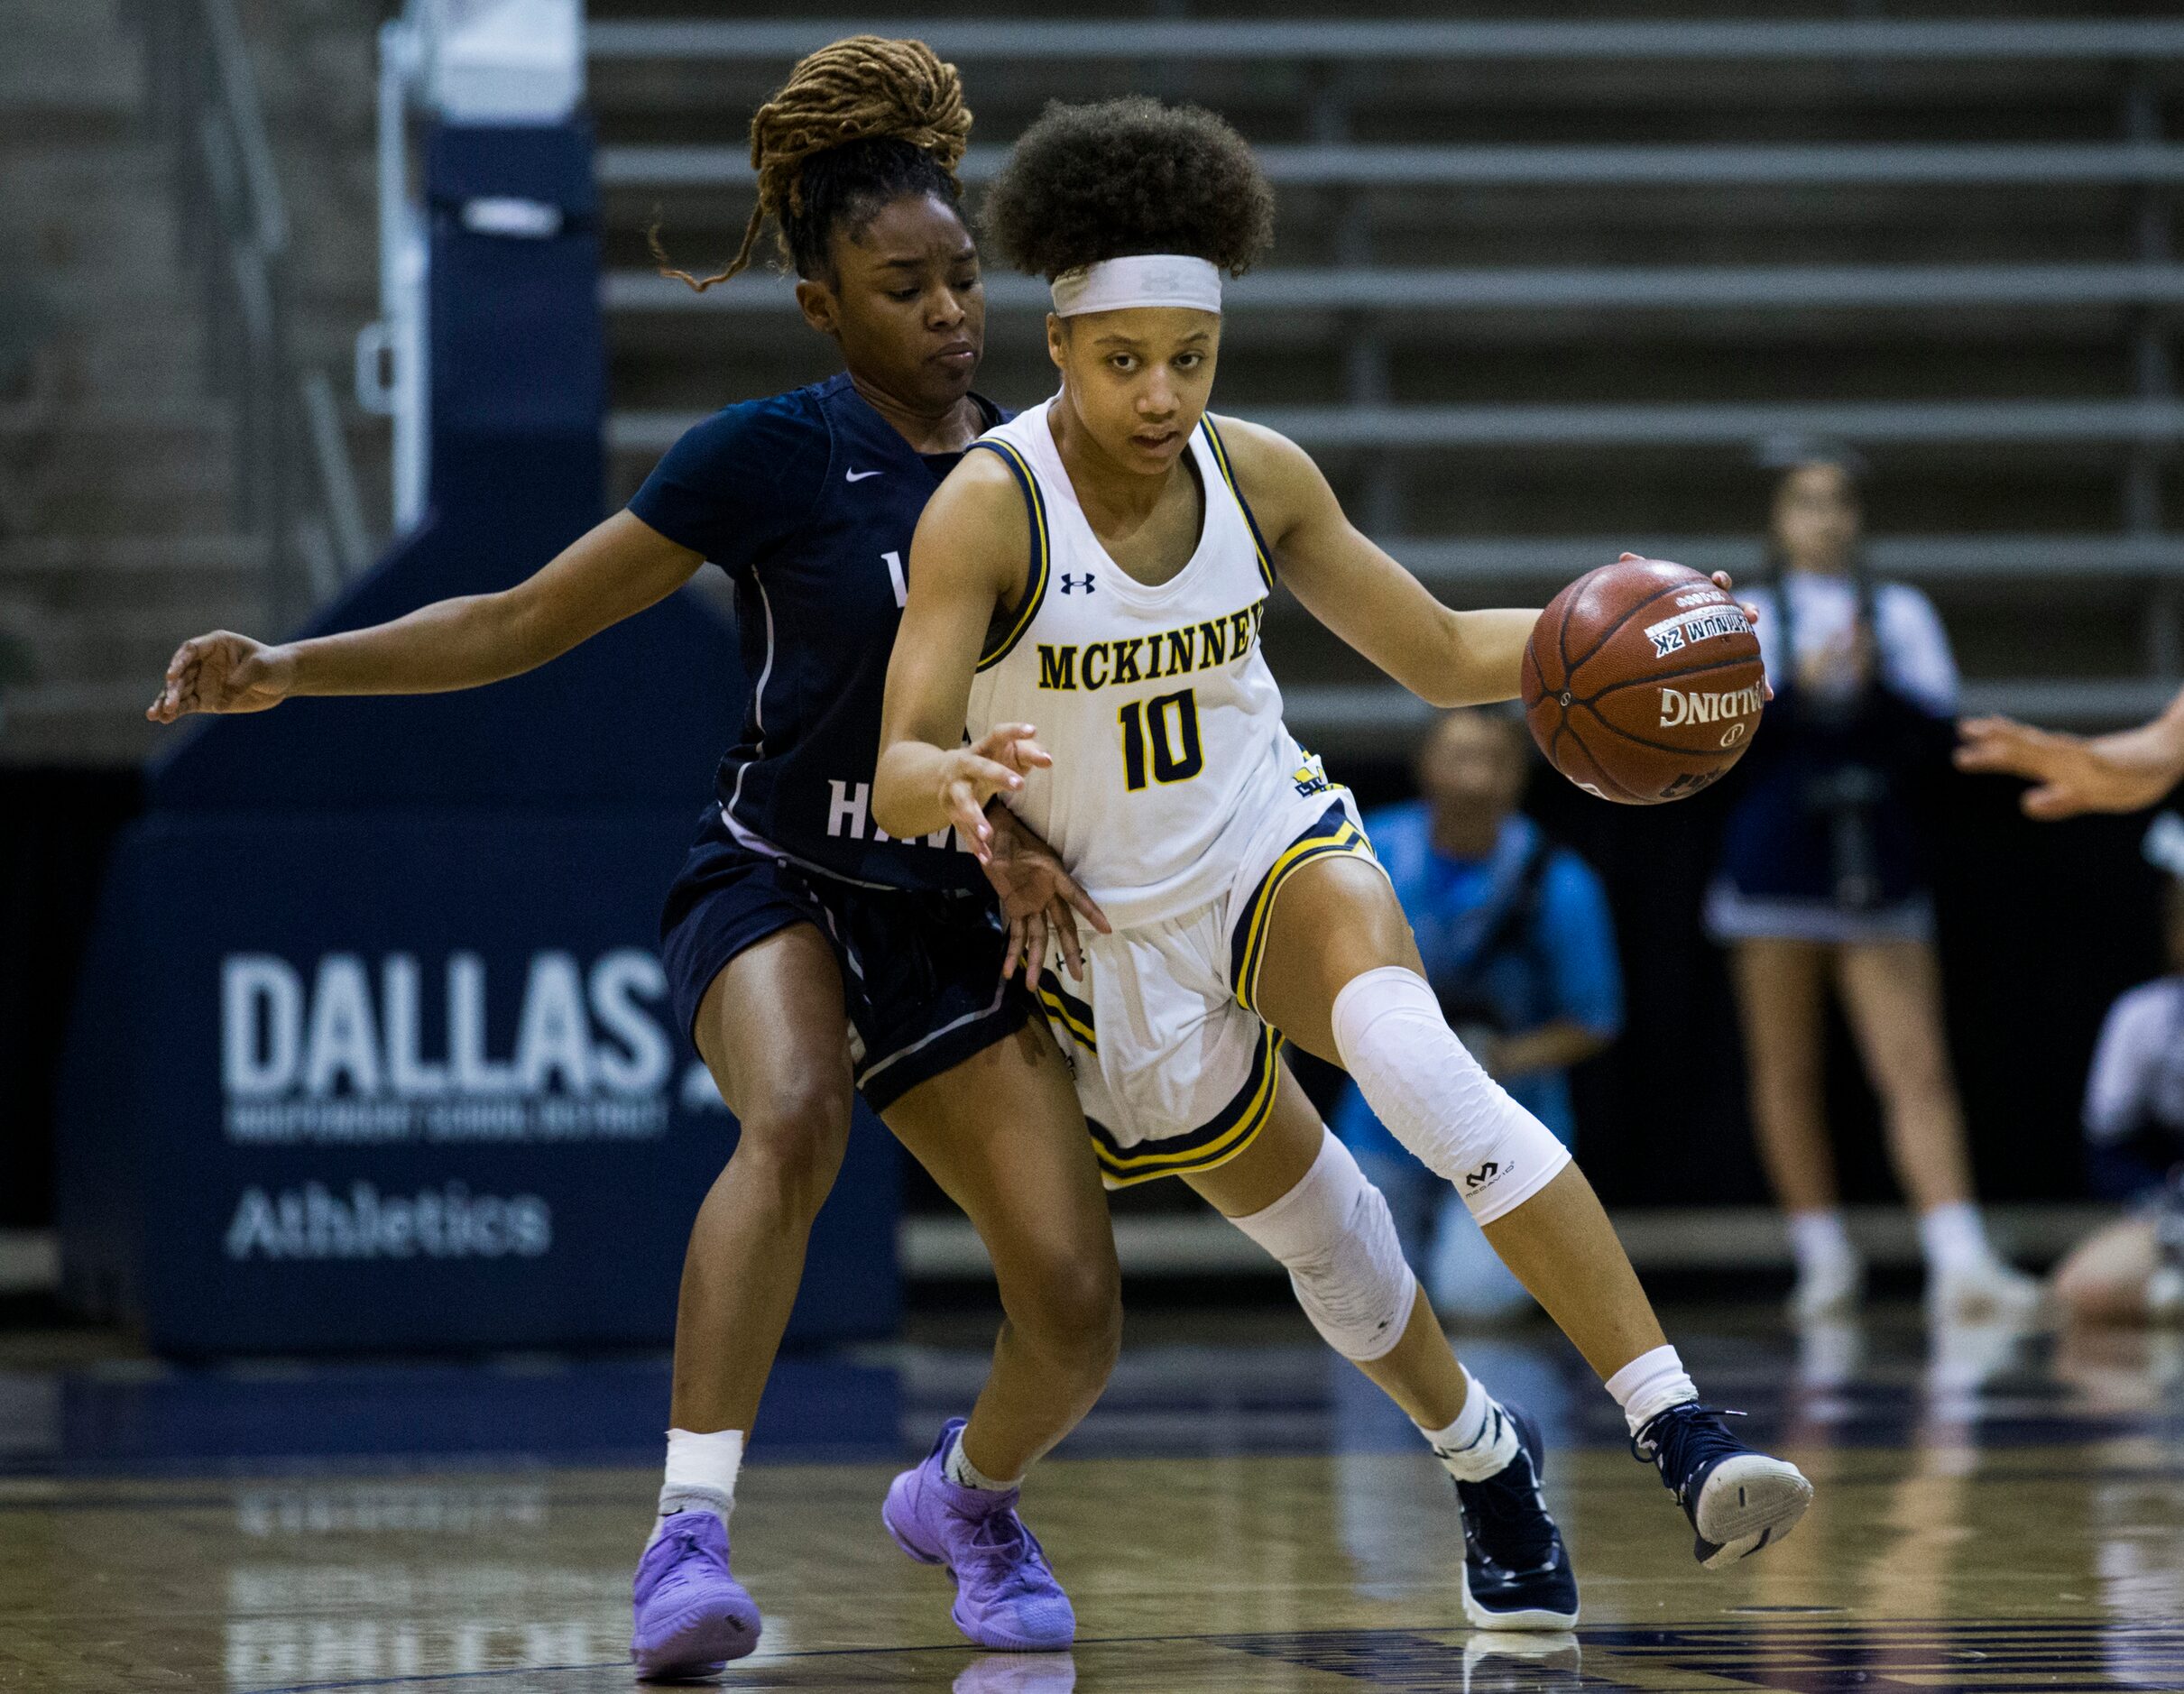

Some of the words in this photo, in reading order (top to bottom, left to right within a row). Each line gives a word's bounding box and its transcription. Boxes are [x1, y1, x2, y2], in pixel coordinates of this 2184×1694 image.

[1118, 688, 1205, 793] 10
[222, 952, 670, 1094] DALLAS
[226, 1180, 550, 1258] Athletics
